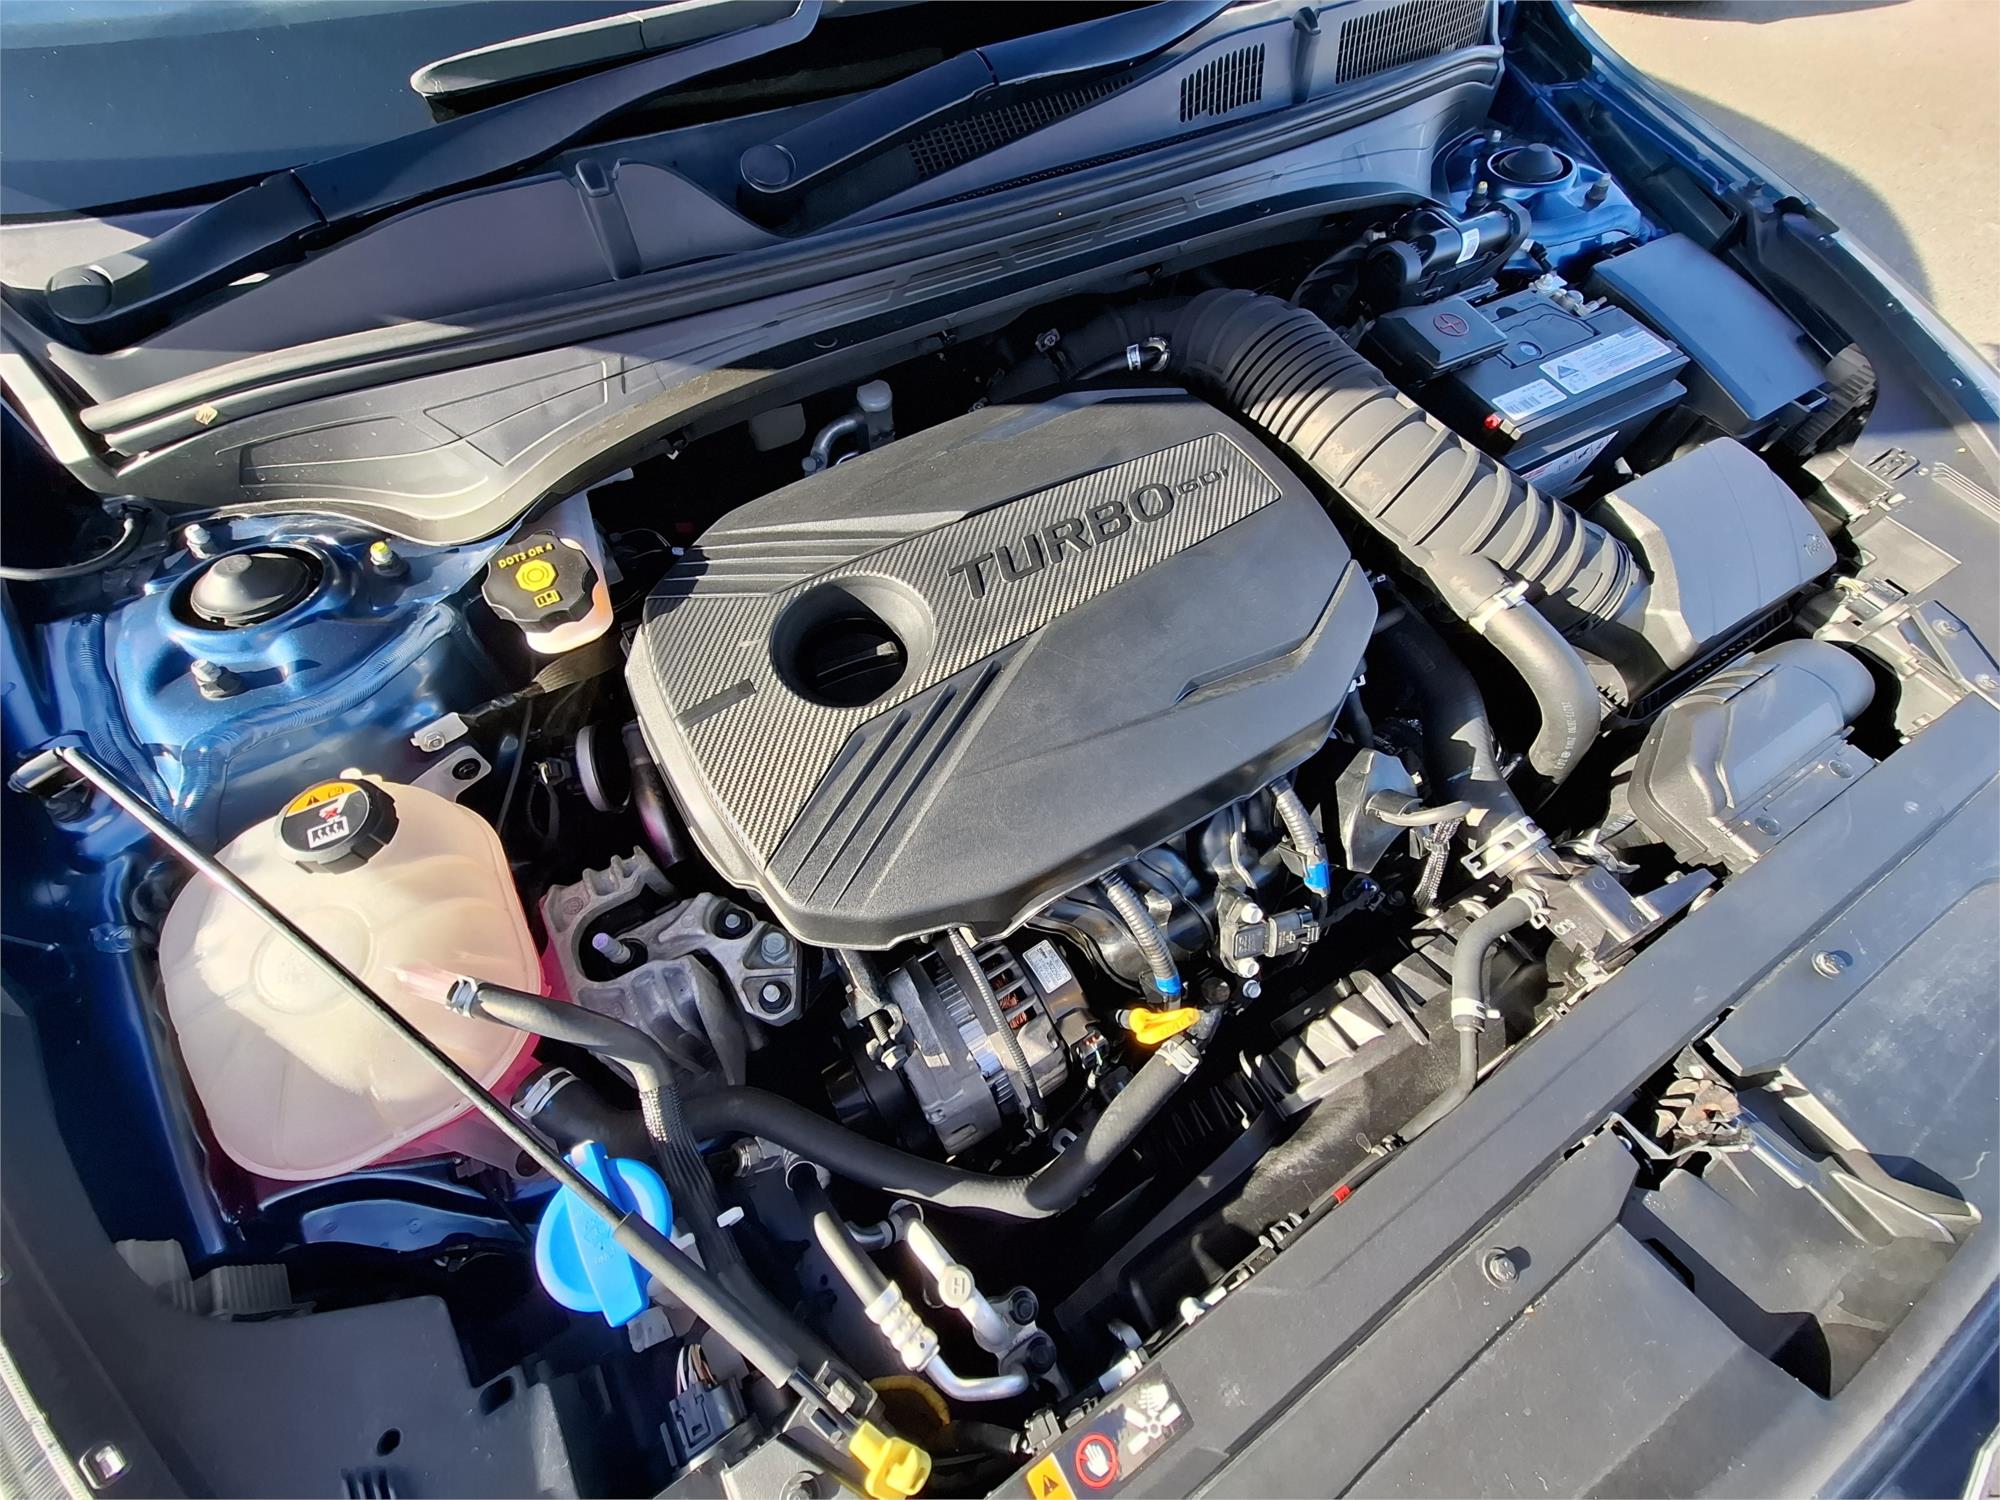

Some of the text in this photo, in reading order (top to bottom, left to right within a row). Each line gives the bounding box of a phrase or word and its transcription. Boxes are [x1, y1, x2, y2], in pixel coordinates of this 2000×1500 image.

[498, 551, 527, 569] DOT3
[528, 544, 545, 557] OR
[947, 468, 1229, 600] TURBO GDI
